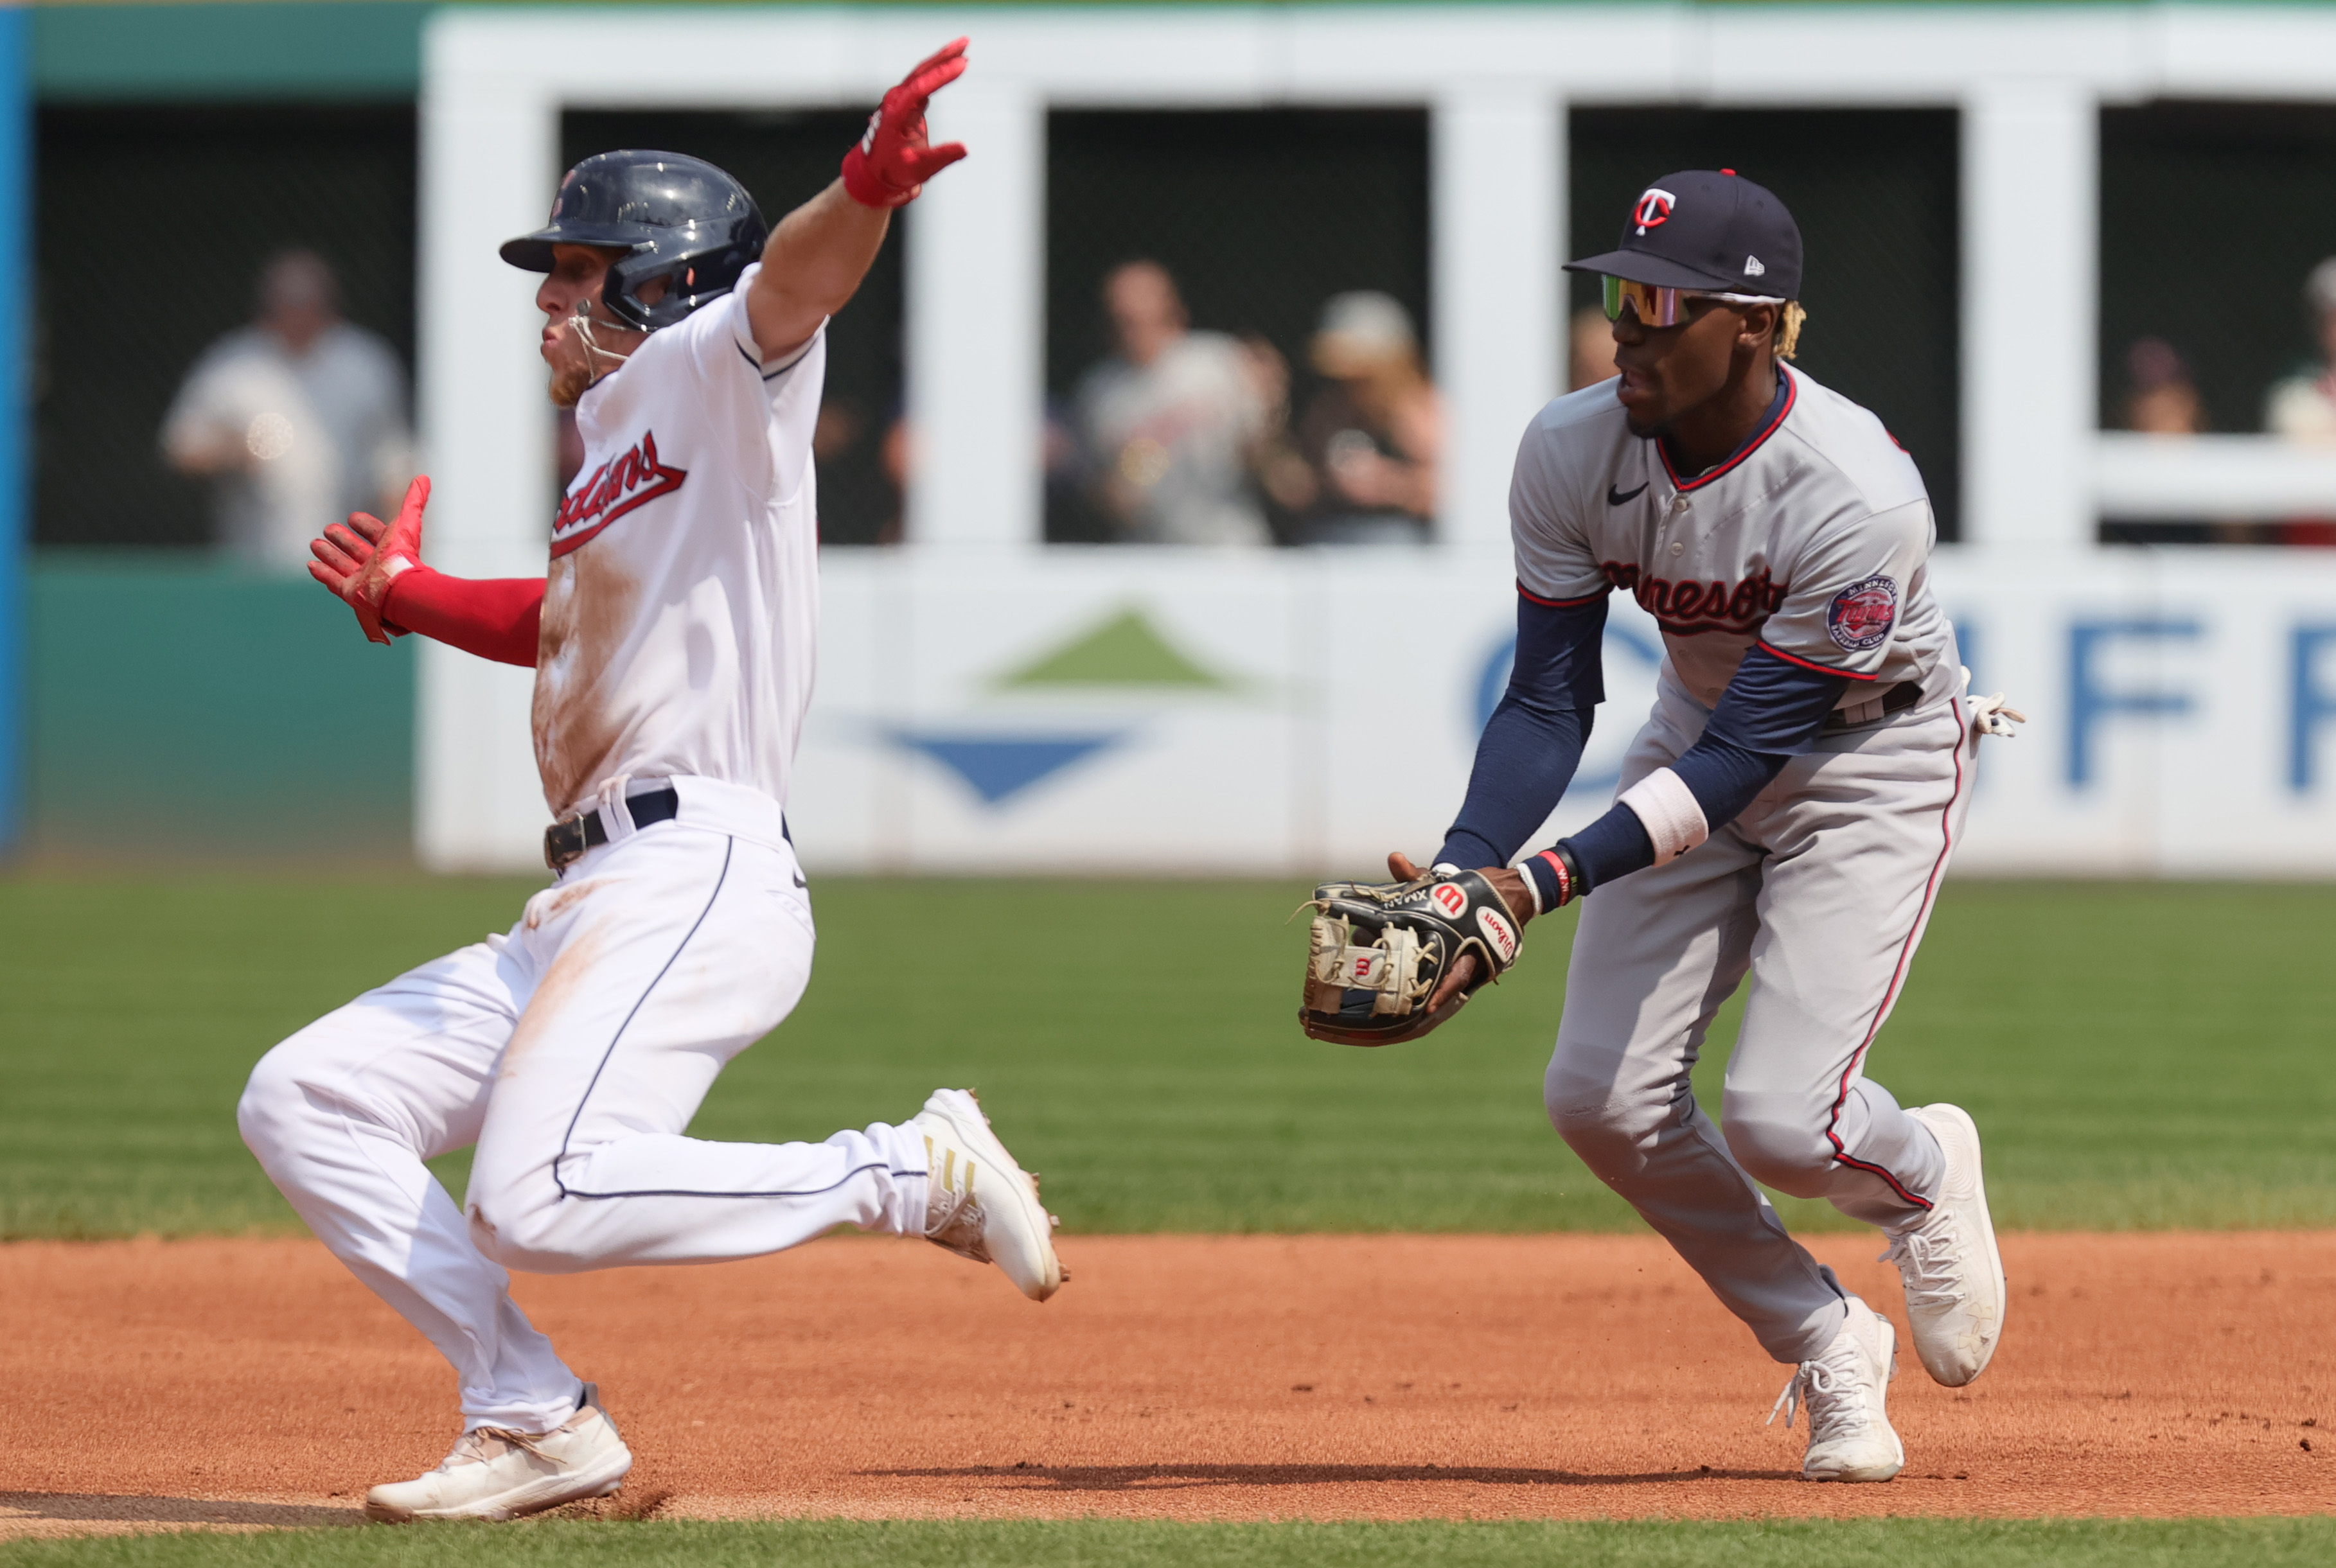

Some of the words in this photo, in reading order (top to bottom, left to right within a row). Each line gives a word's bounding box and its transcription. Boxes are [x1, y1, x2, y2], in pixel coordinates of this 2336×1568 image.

[1837, 599, 1895, 622] Twins
[1862, 633, 1884, 645] CLUB
[1483, 912, 1515, 958] Wilson
